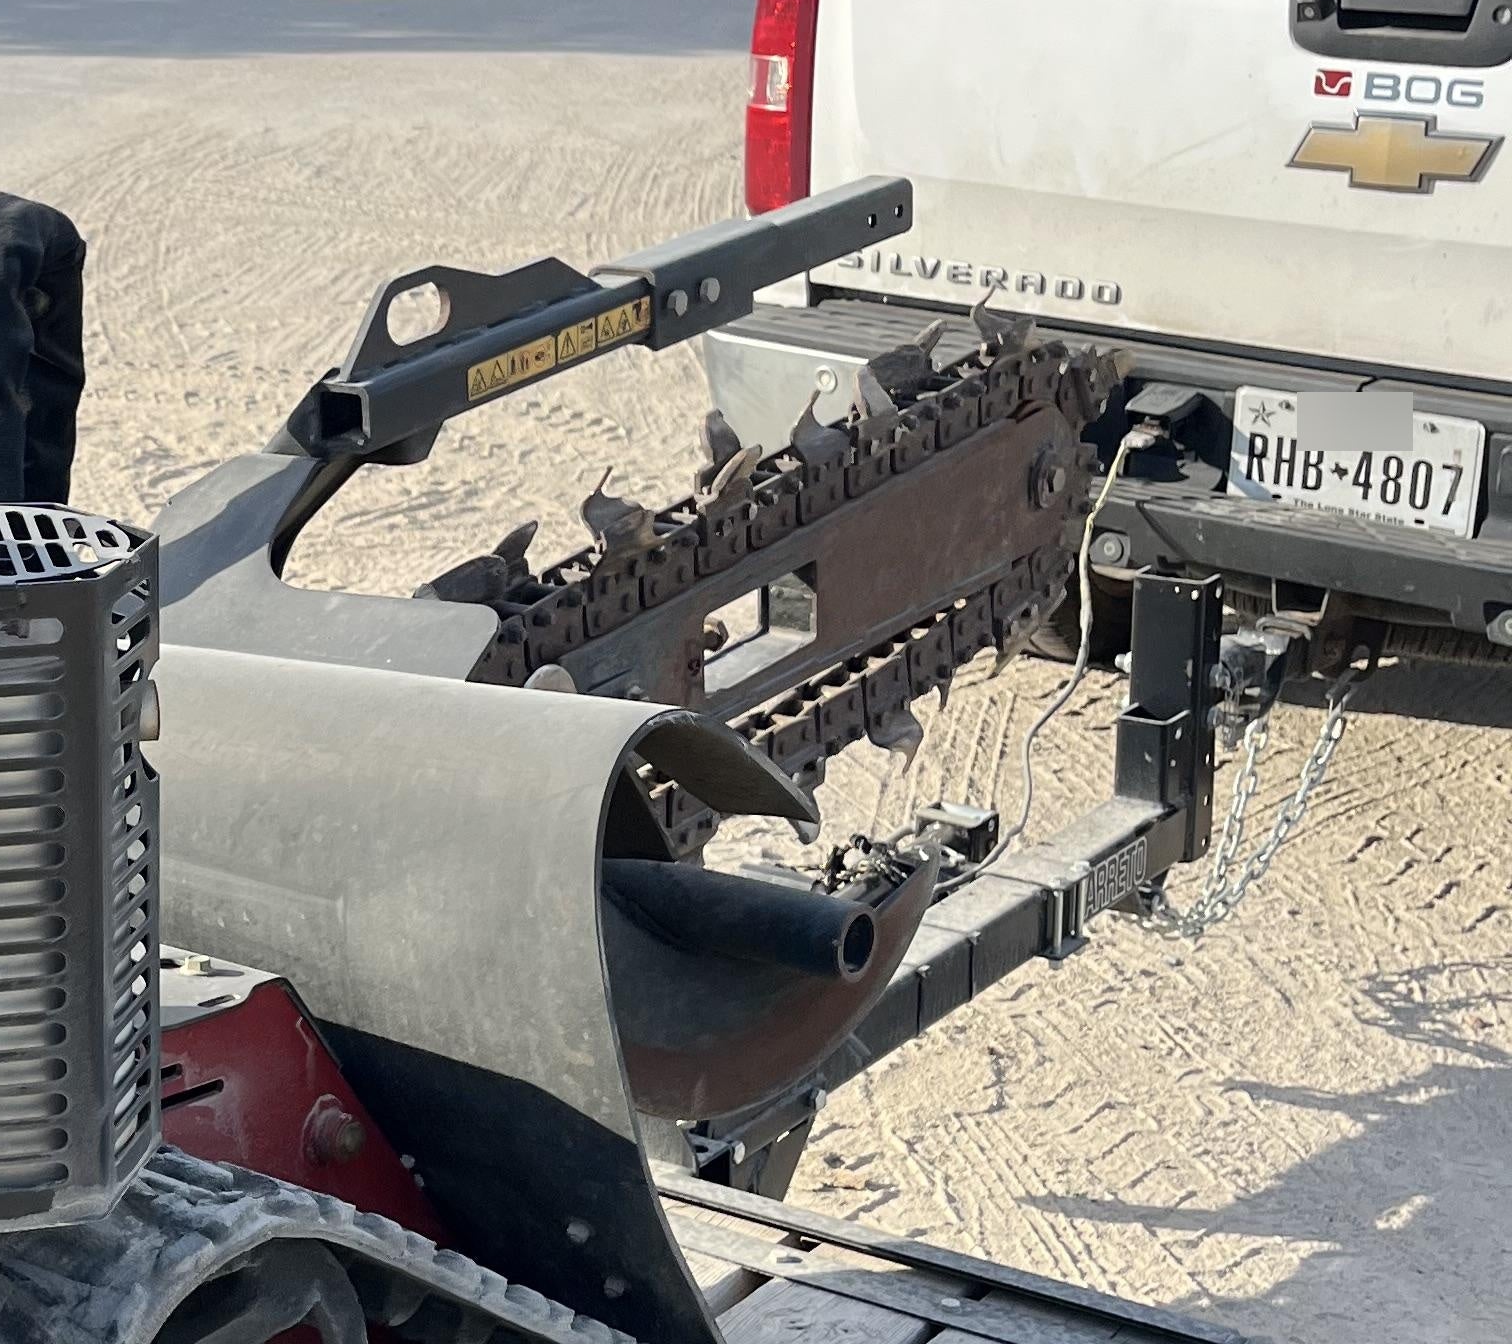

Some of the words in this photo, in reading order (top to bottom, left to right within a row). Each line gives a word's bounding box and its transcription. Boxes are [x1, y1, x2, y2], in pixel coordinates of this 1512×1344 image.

[1364, 71, 1484, 108] BOG
[837, 250, 1123, 305] SILVERADO
[1352, 451, 1464, 516] 4807
[1084, 836, 1148, 918] ARRETO
